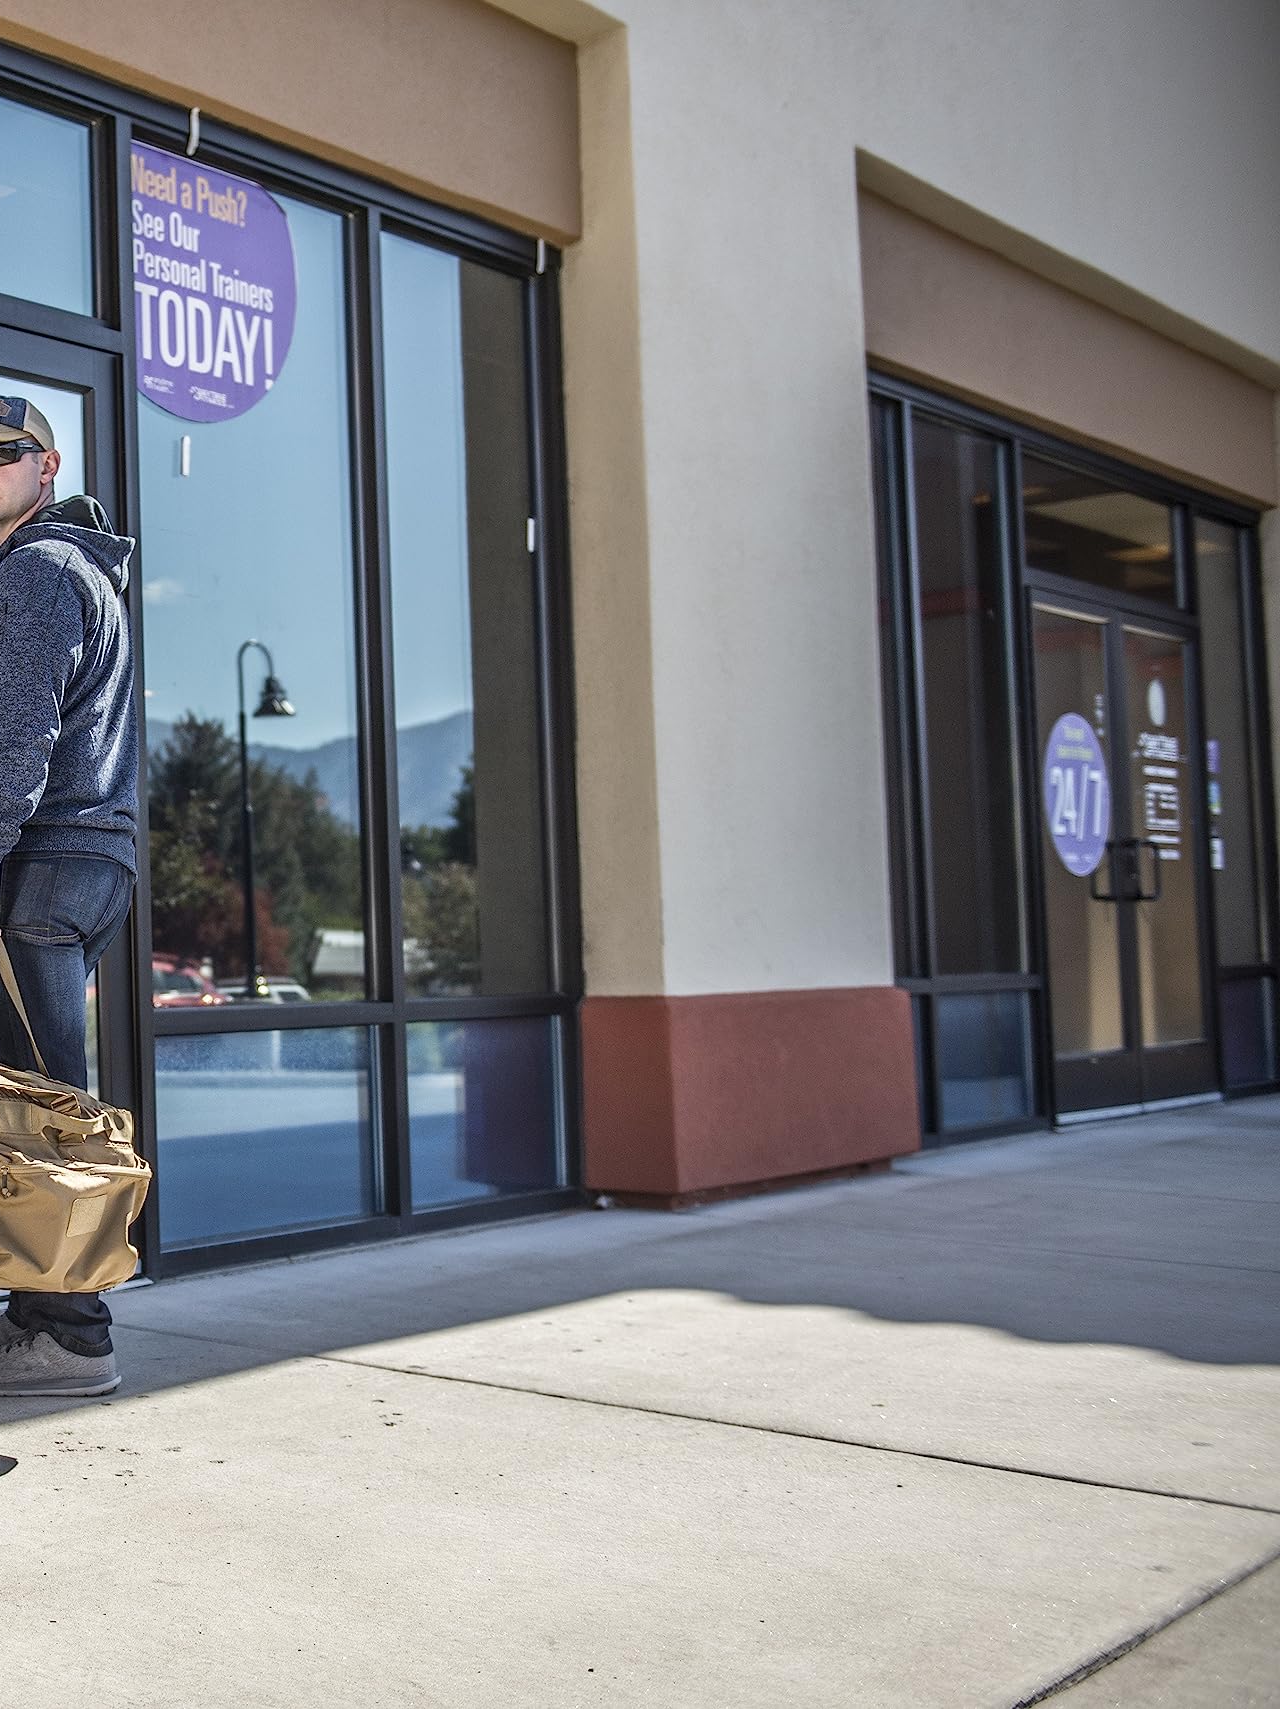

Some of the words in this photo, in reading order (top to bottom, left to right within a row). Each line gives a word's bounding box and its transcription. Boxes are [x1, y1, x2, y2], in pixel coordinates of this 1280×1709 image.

[131, 153, 177, 205] Need
[181, 181, 193, 210] a
[196, 175, 247, 228] Push?
[132, 198, 165, 242] See
[169, 211, 200, 253] Our
[133, 238, 207, 293] Personal
[209, 260, 274, 313] Trainers
[134, 280, 275, 391] TODAY!
[1050, 763, 1102, 842] 24/7
